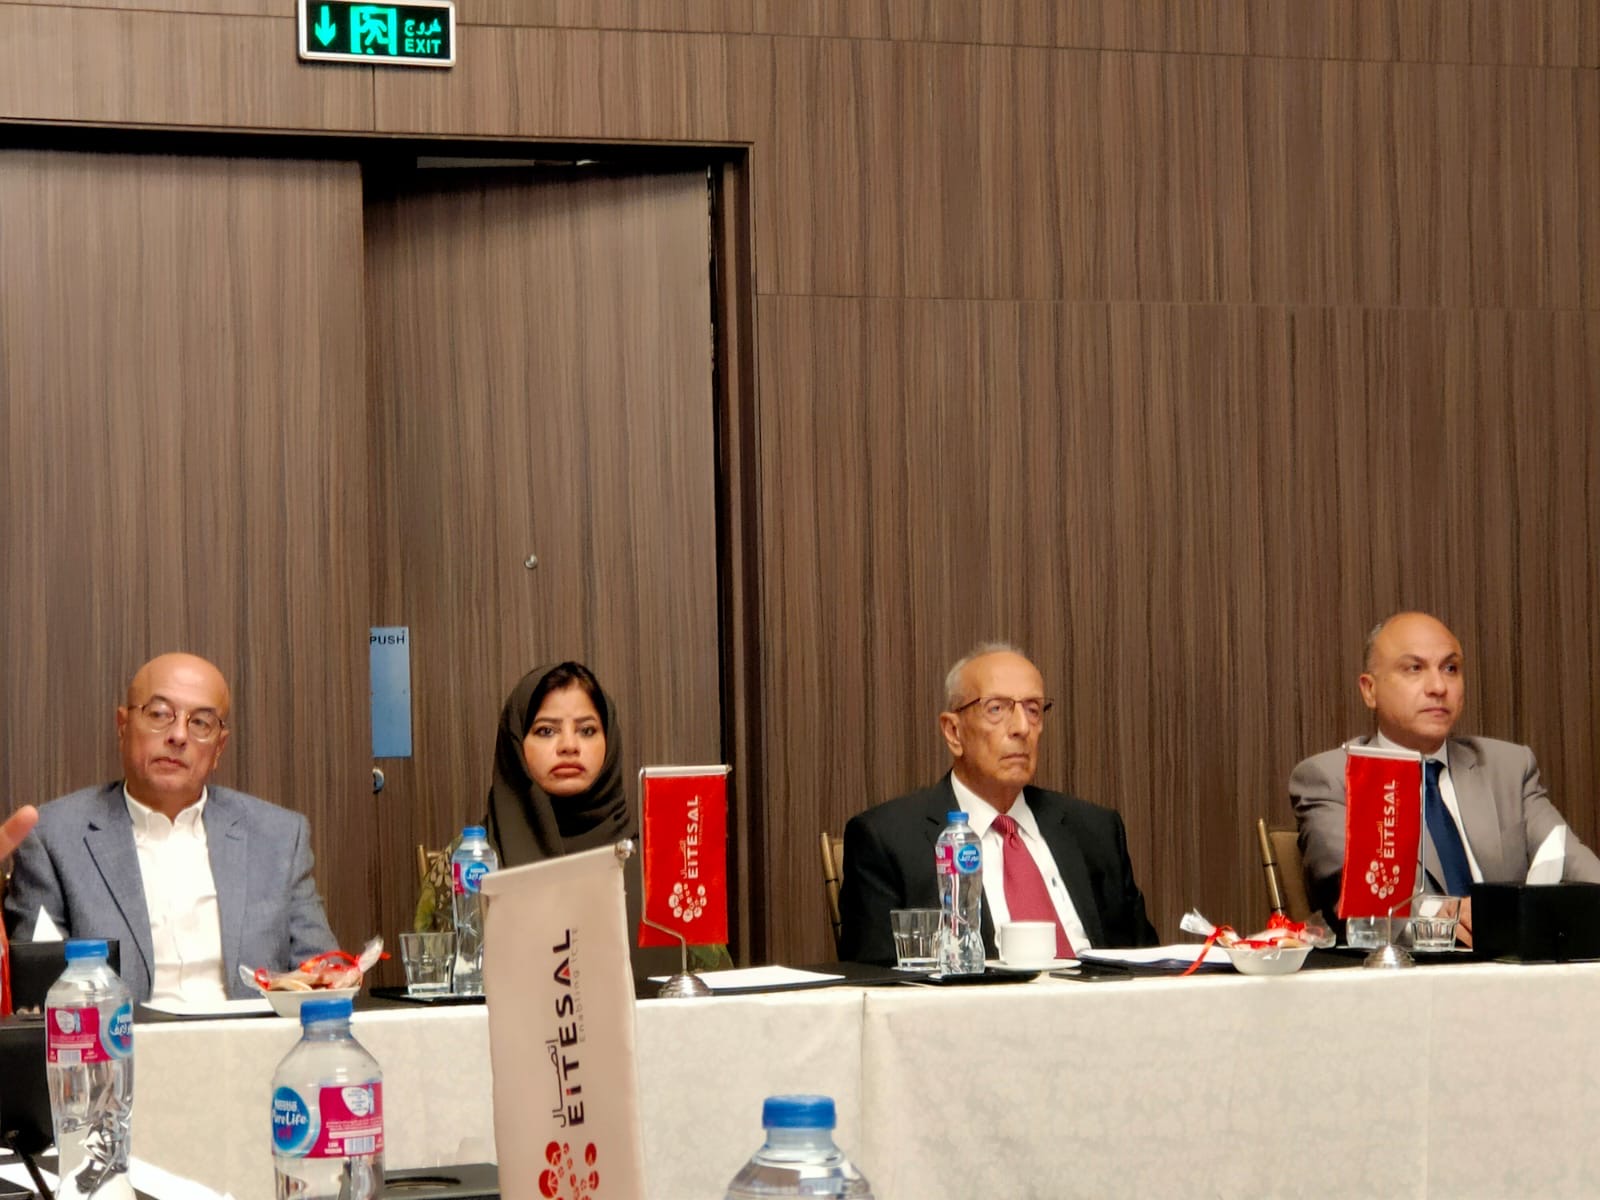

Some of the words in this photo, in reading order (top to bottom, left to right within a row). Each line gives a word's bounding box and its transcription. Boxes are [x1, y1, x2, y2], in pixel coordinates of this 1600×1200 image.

[404, 18, 442, 37] خروج
[404, 38, 442, 54] EXIT
[369, 635, 405, 645] PUSH
[1383, 779, 1396, 859] EITESAL
[687, 794, 699, 879] EITESAL
